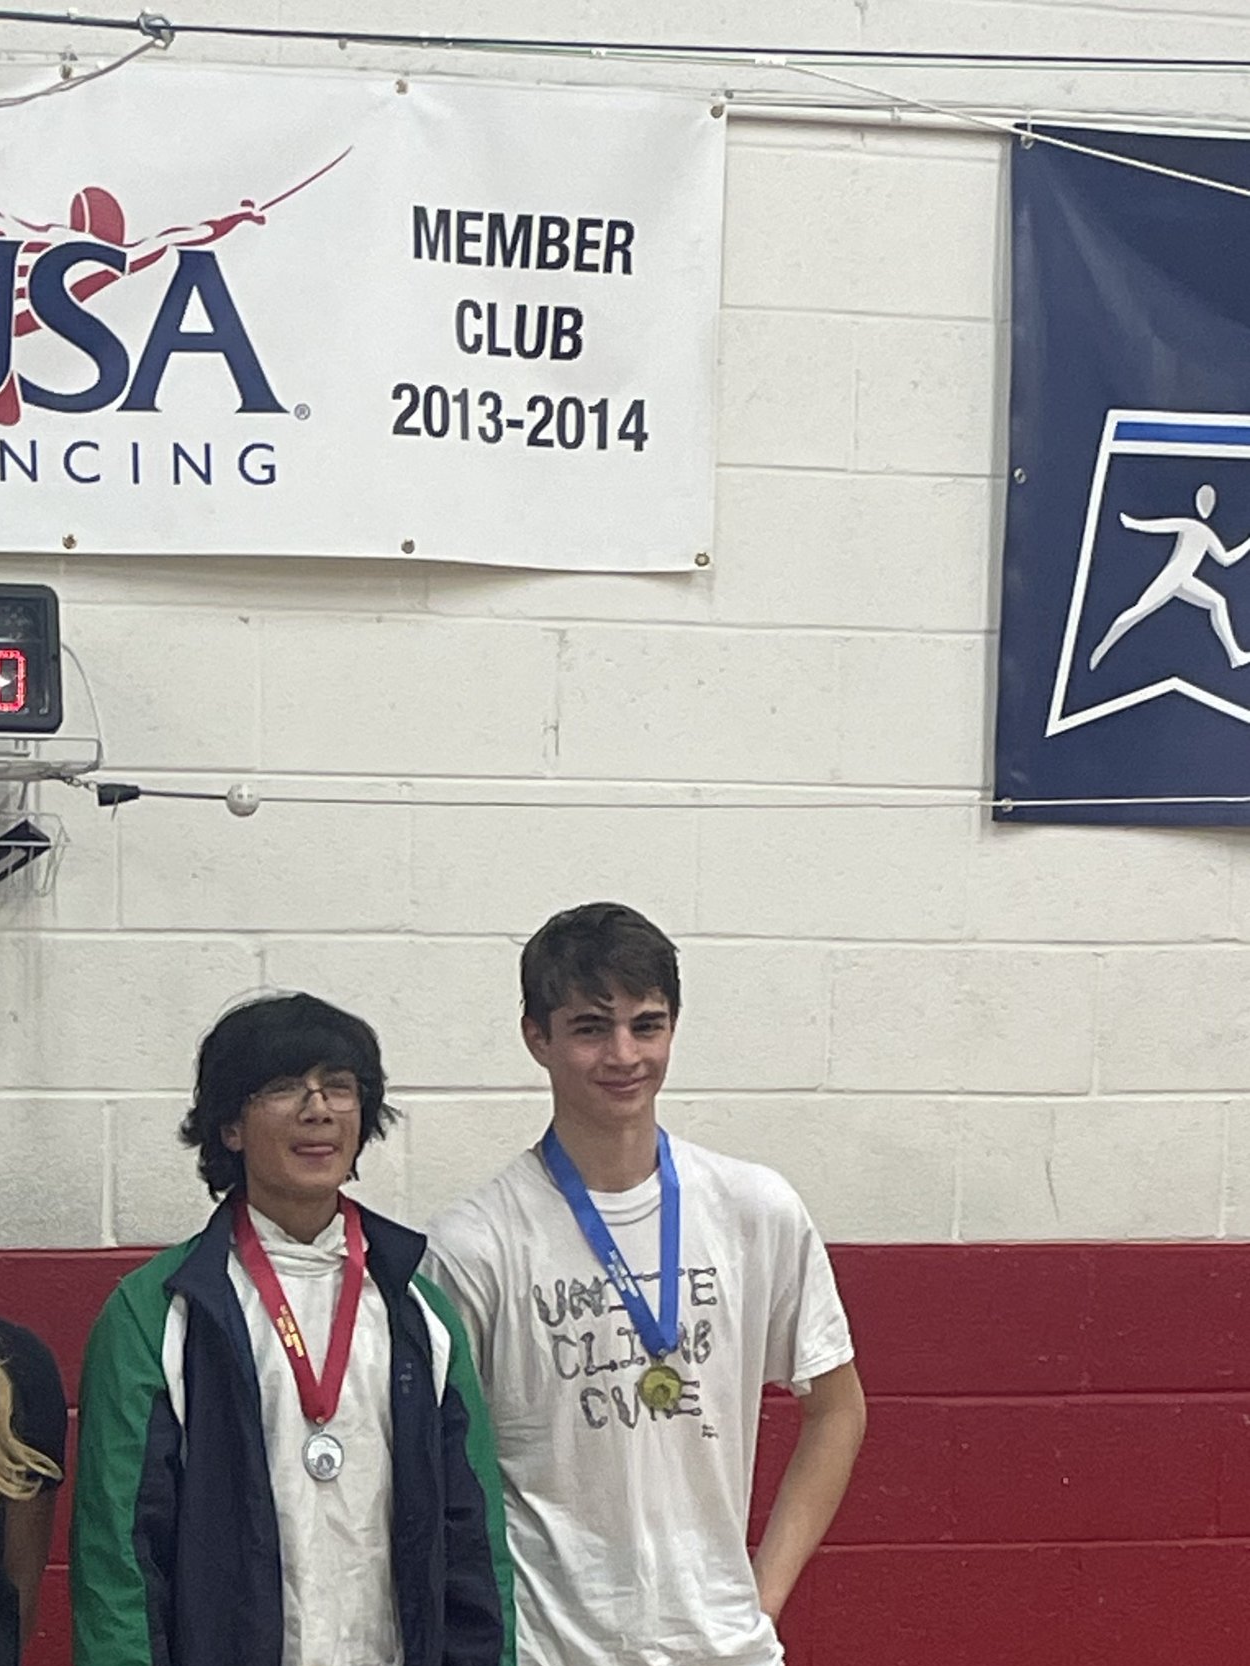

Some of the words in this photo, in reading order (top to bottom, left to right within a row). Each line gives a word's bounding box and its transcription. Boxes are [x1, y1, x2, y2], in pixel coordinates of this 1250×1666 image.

[412, 205, 635, 276] MEMBER
[455, 299, 584, 361] CLUB
[391, 382, 649, 452] 2013-2014
